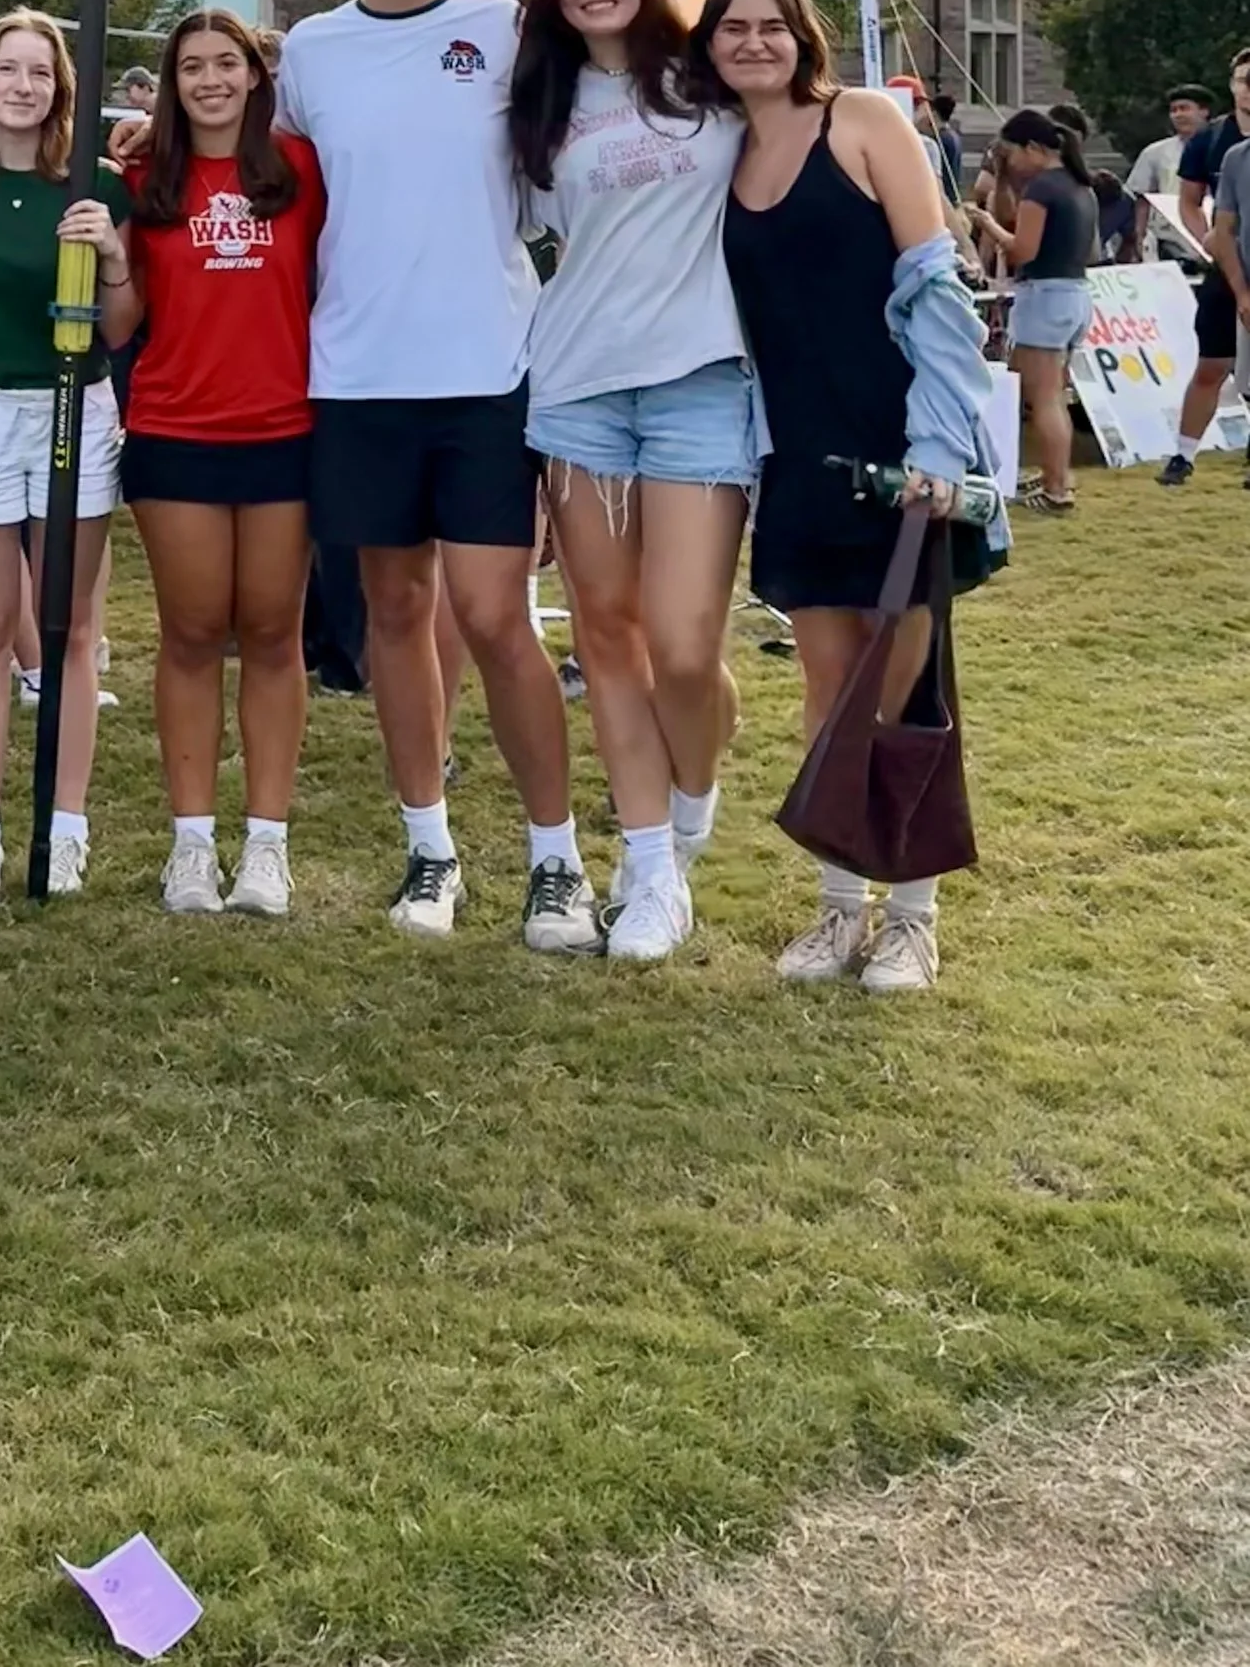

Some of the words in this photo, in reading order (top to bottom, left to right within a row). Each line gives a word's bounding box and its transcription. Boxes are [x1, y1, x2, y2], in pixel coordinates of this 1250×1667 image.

[441, 55, 486, 70] WASH
[190, 218, 271, 244] WASH
[203, 256, 265, 271] ROWING
[1086, 270, 1139, 301] en's
[1094, 345, 1175, 395] Polo
